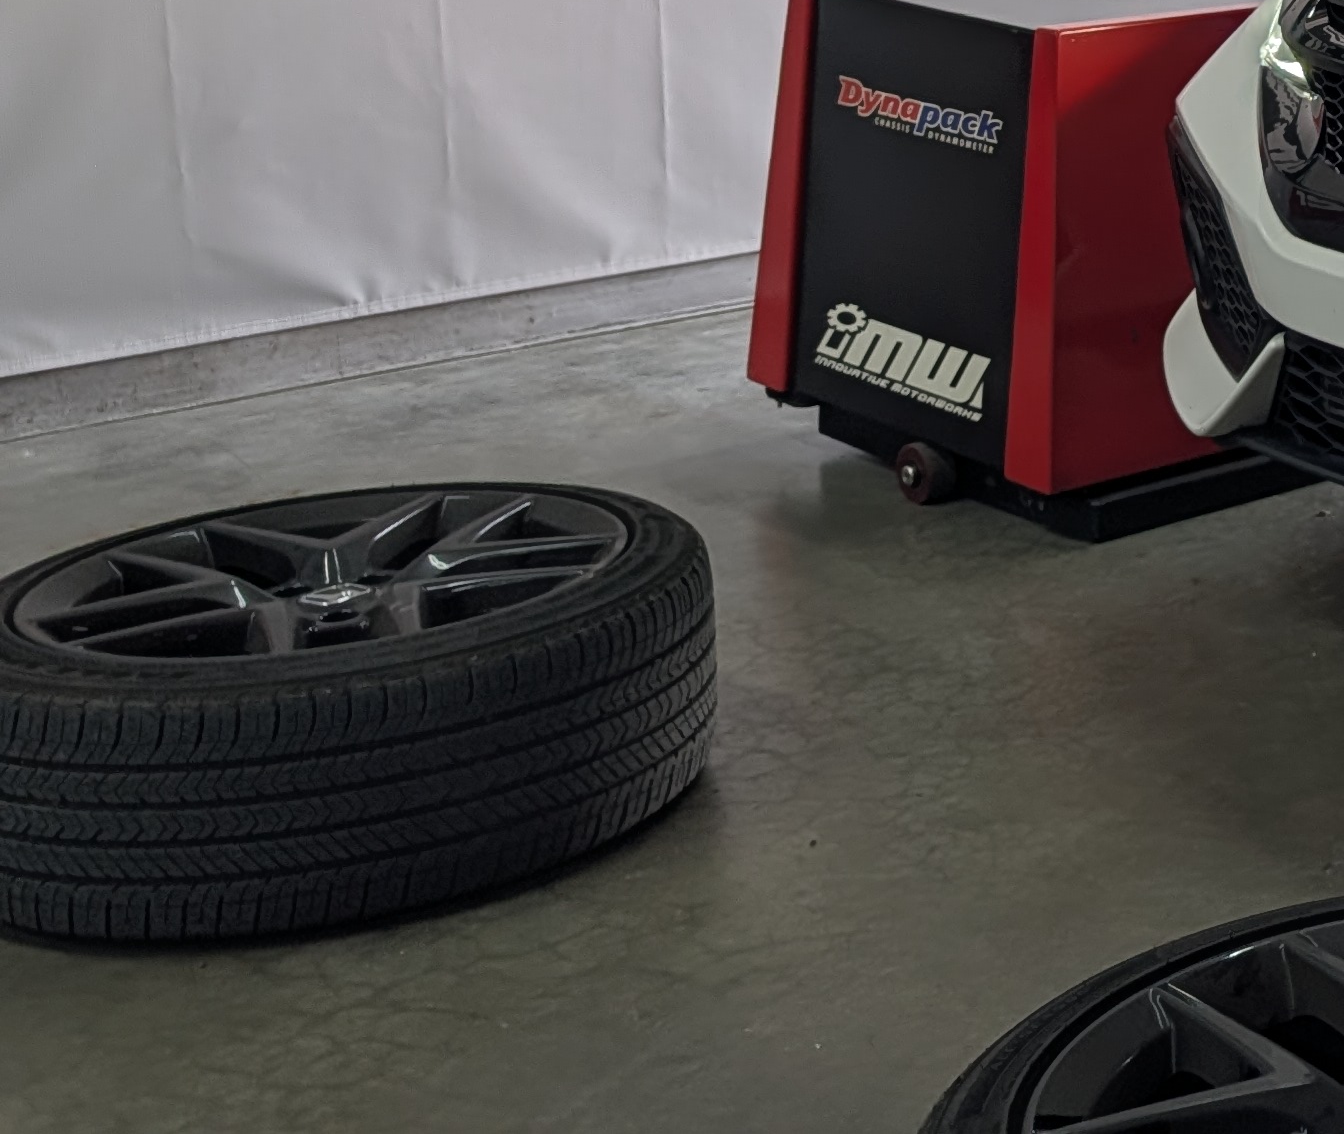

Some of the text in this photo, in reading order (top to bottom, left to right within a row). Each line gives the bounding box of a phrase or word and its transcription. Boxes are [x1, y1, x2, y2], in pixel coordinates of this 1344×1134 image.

[837, 75, 1003, 145] Dynapack
[873, 116, 994, 155] CHASSIS DYNAMOMETER
[814, 355, 983, 423] INNOVATIVE MOTORWORKS
